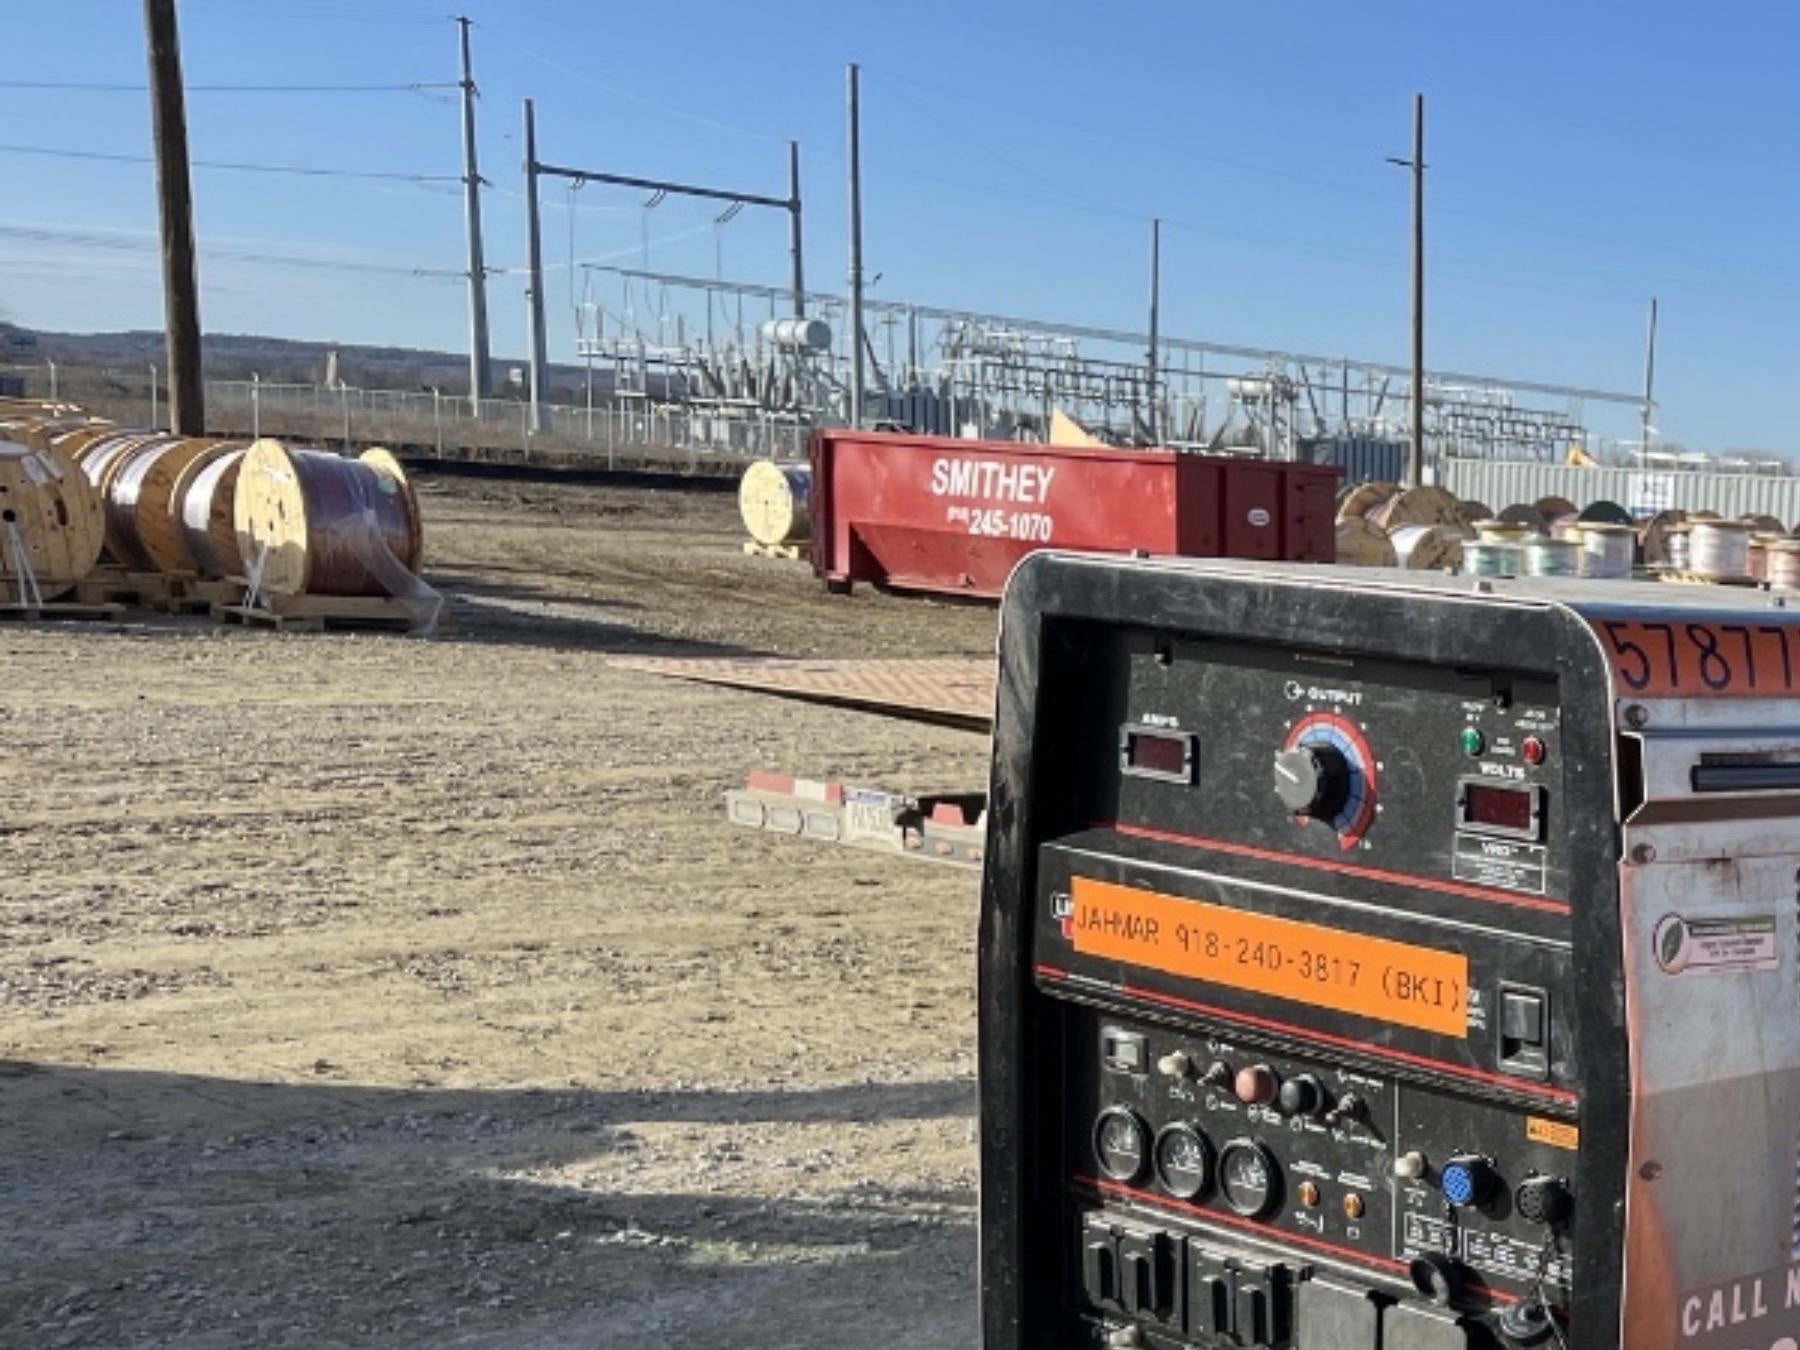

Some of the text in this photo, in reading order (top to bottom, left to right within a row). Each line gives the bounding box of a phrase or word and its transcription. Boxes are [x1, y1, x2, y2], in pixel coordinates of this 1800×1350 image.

[931, 457, 1056, 504] SMITHEY
[968, 508, 1054, 543] 245-1070
[1382, 965, 1460, 1013] (BKI)
[1682, 1282, 1768, 1336] CALL
